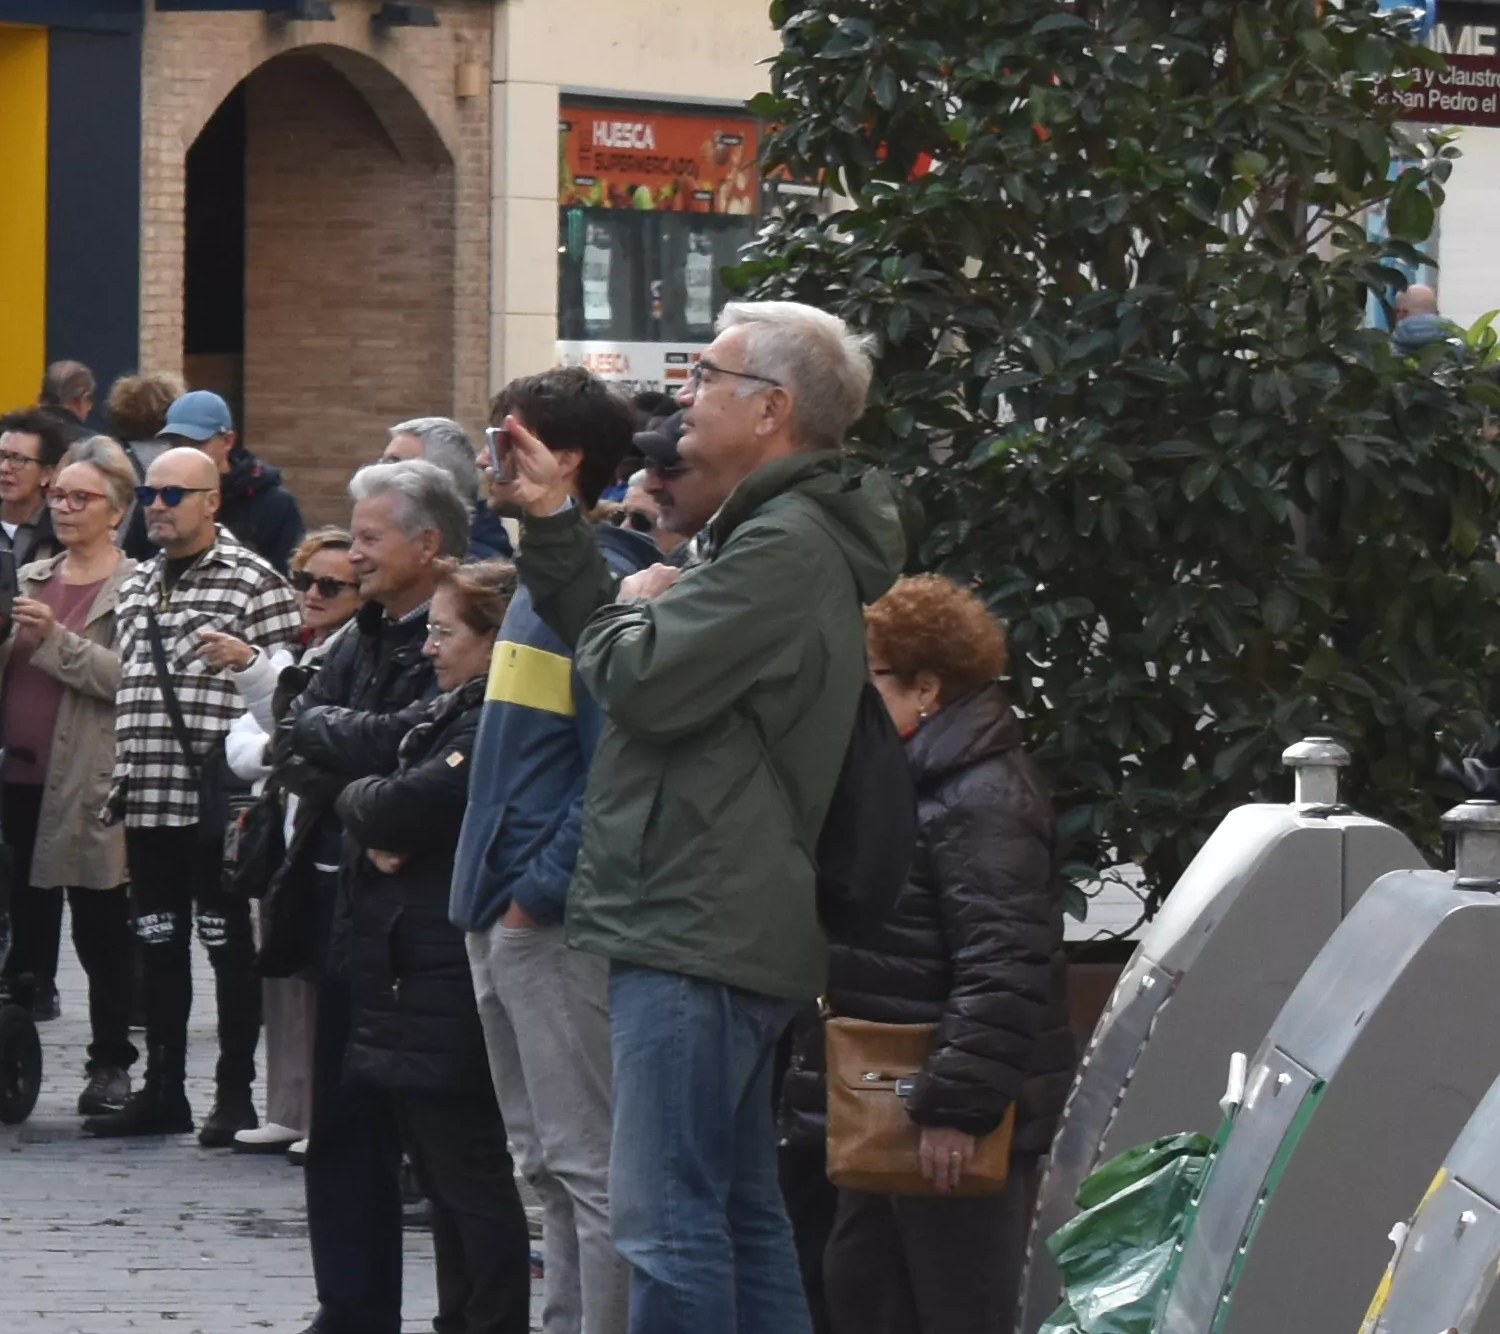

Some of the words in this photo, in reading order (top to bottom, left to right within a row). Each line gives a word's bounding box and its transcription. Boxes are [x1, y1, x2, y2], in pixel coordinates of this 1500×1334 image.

[1428, 89, 1478, 112] Pedro
[1481, 94, 1498, 113] el
[593, 121, 655, 151] HUESCA
